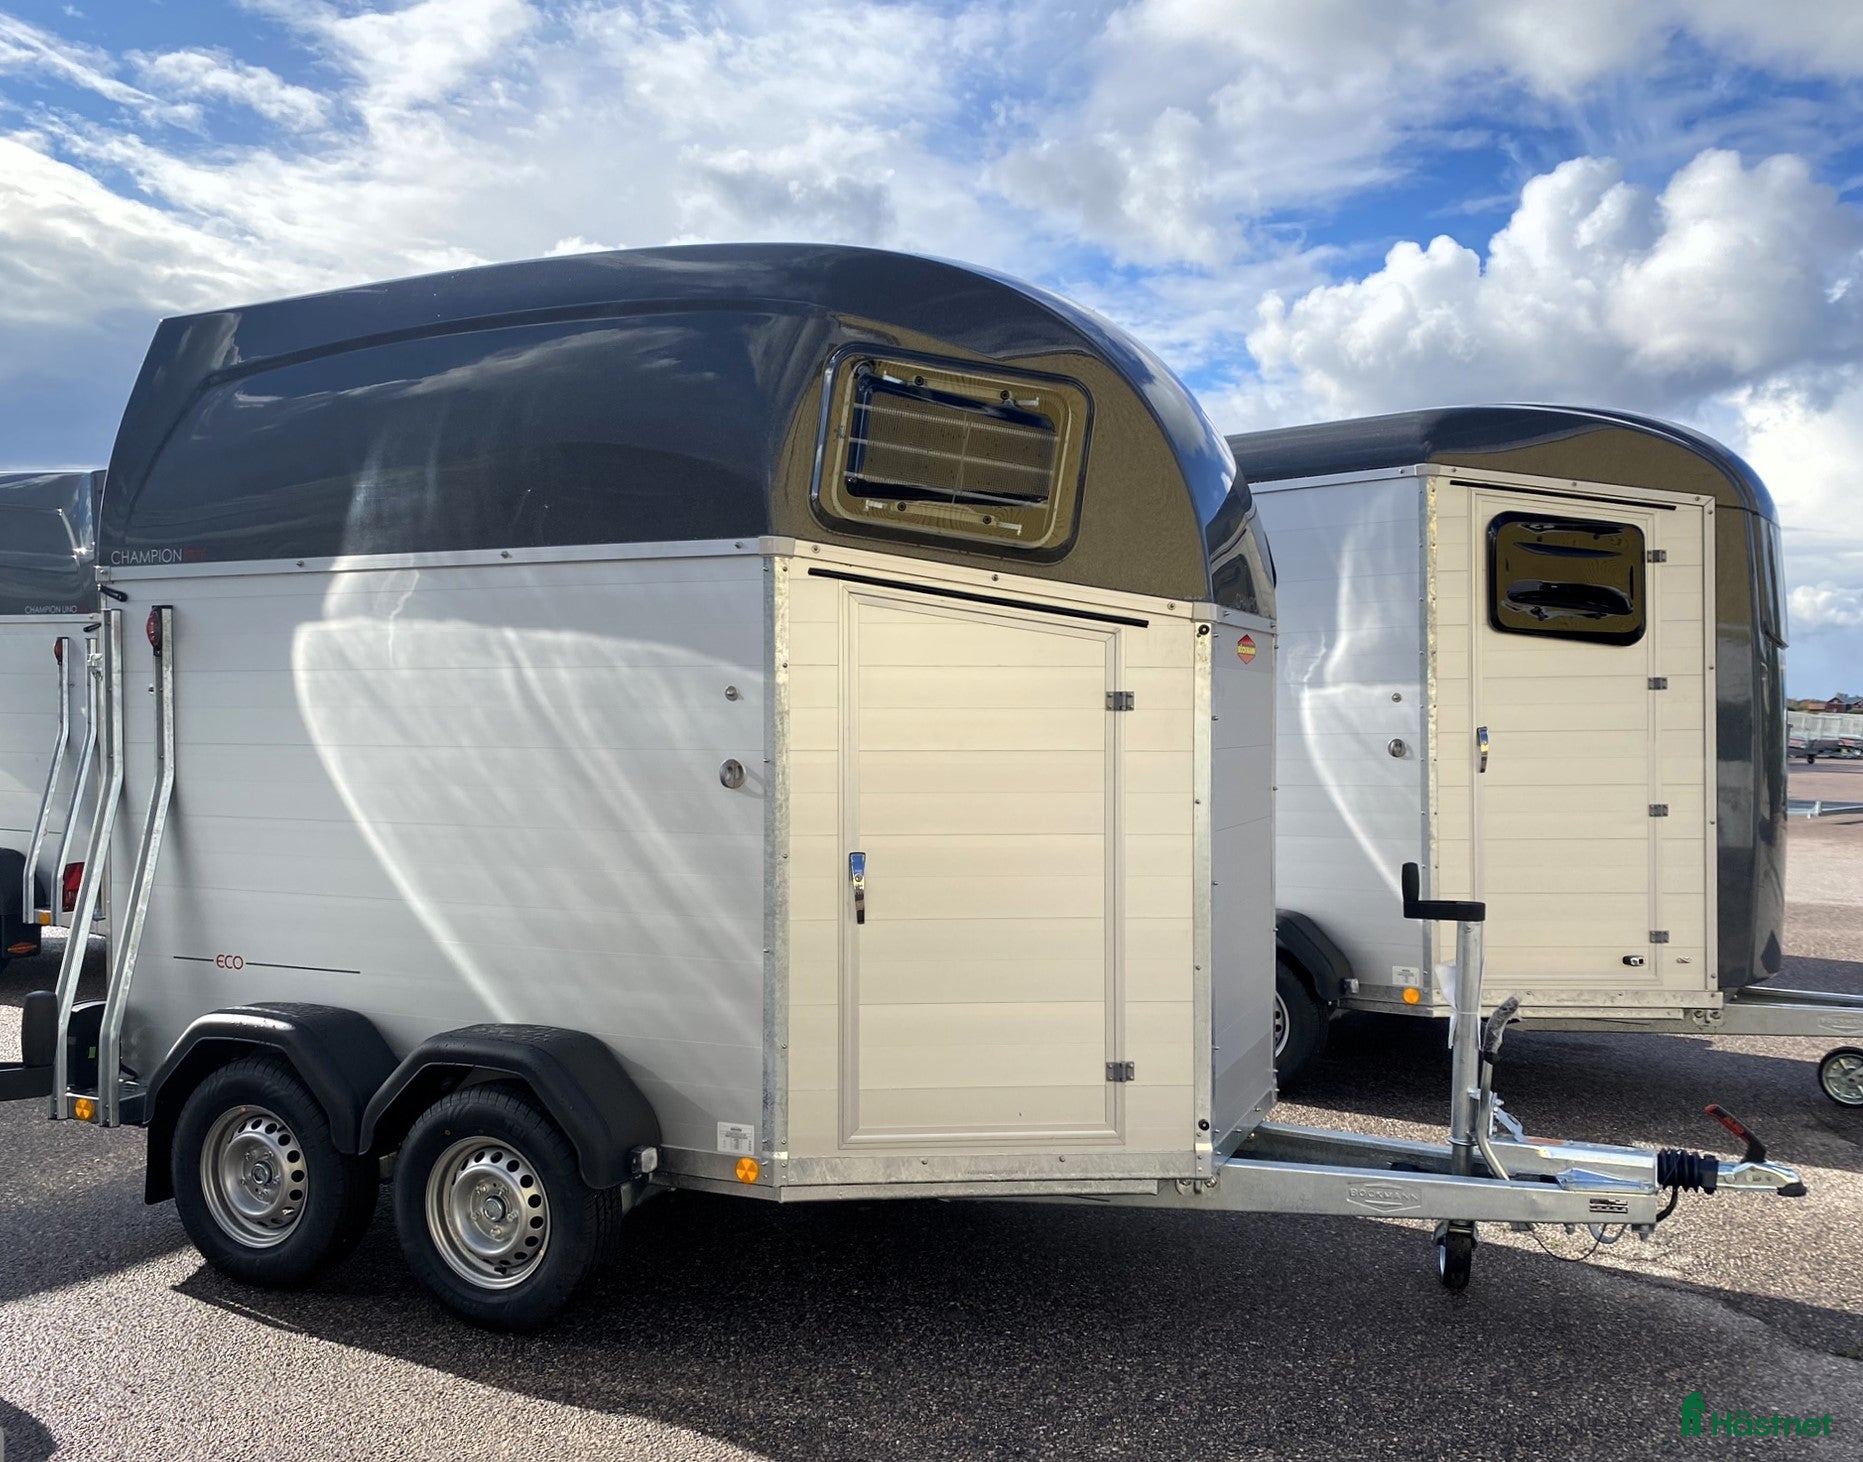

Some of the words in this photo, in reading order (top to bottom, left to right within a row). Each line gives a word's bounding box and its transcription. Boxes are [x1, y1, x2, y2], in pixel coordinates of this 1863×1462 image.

[110, 548, 183, 565] CHAMPION
[24, 604, 60, 615] CHAMPION
[216, 954, 244, 970] ECO
